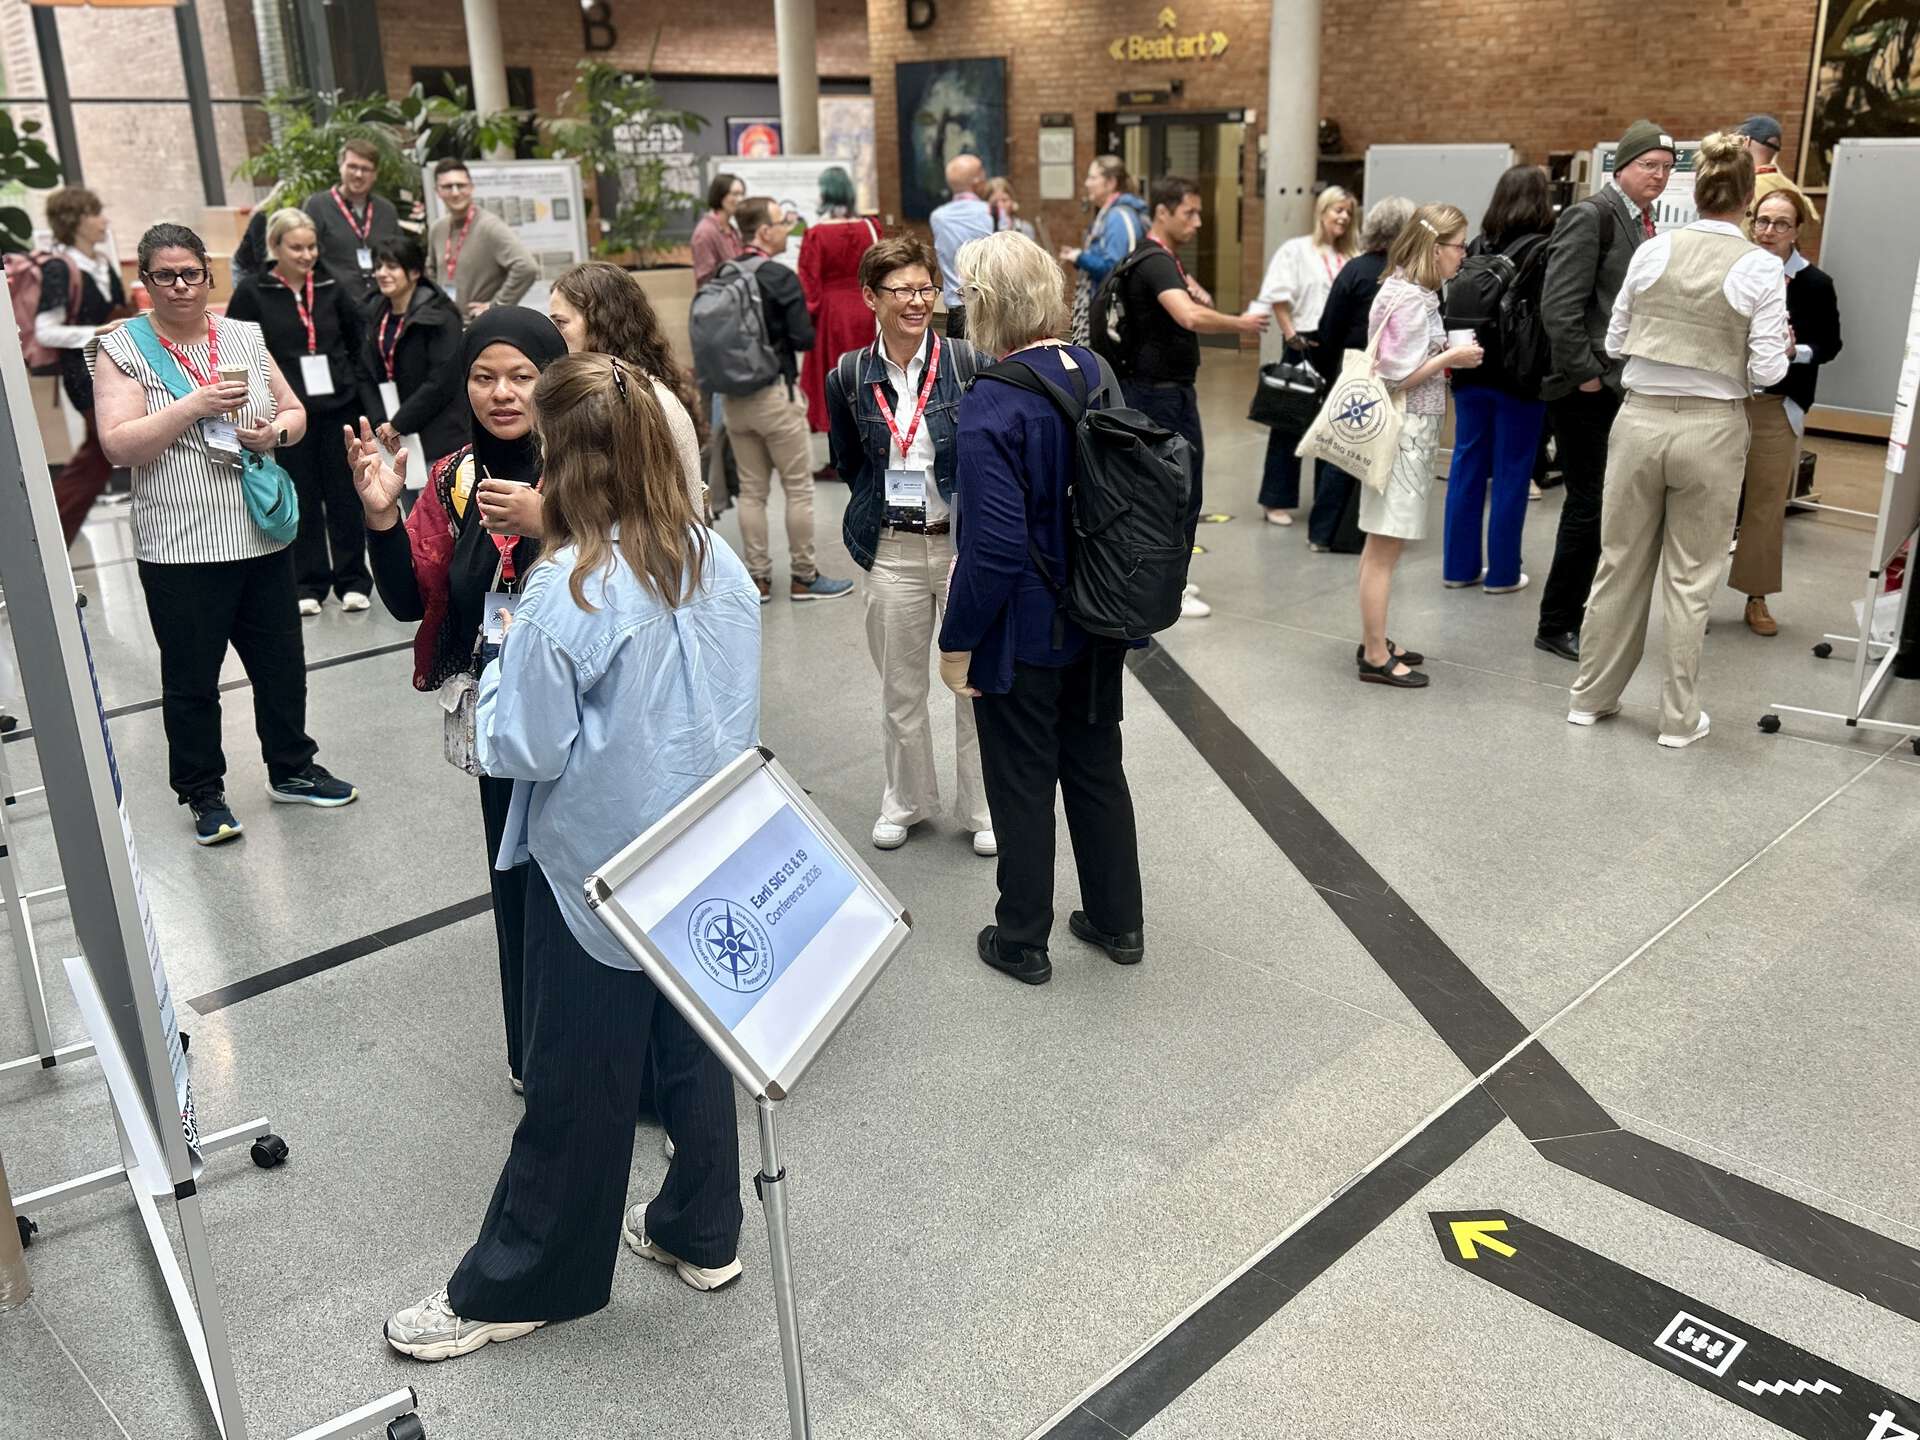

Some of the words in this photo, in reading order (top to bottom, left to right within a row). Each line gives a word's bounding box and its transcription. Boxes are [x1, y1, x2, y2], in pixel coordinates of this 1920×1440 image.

[581, 0, 618, 52] B
[1127, 34, 1174, 60] Beat
[1176, 32, 1206, 58] art
[790, 857, 801, 869] &
[795, 849, 808, 863] 19
[768, 871, 787, 891] SIG
[782, 863, 795, 877] 13
[750, 884, 774, 909] Earli
[766, 883, 807, 926] Conference
[695, 938, 720, 977] Navigating
[743, 969, 767, 985] Fostering
